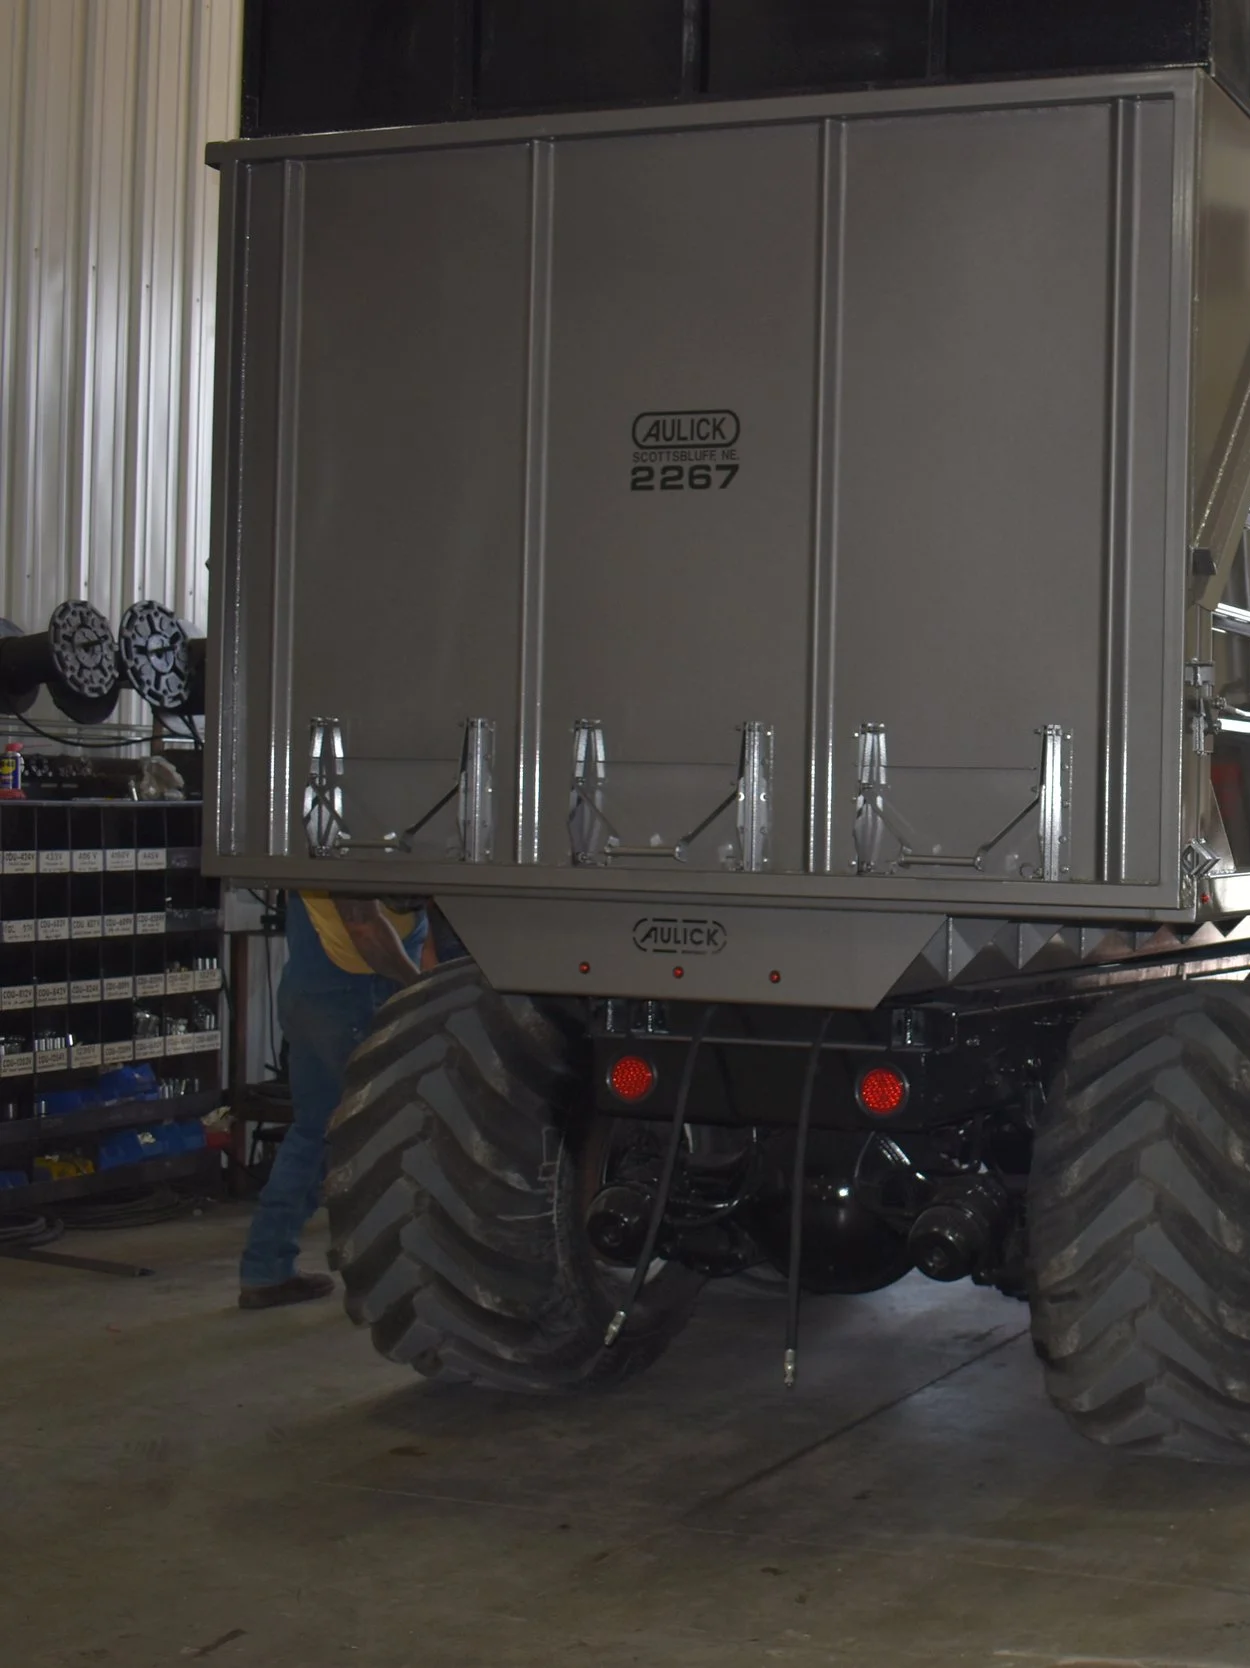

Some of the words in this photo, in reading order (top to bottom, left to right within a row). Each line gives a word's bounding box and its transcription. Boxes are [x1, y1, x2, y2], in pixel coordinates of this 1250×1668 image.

[642, 416, 726, 443] AULICK
[631, 464, 739, 491] 2267
[640, 926, 719, 946] AULICK
